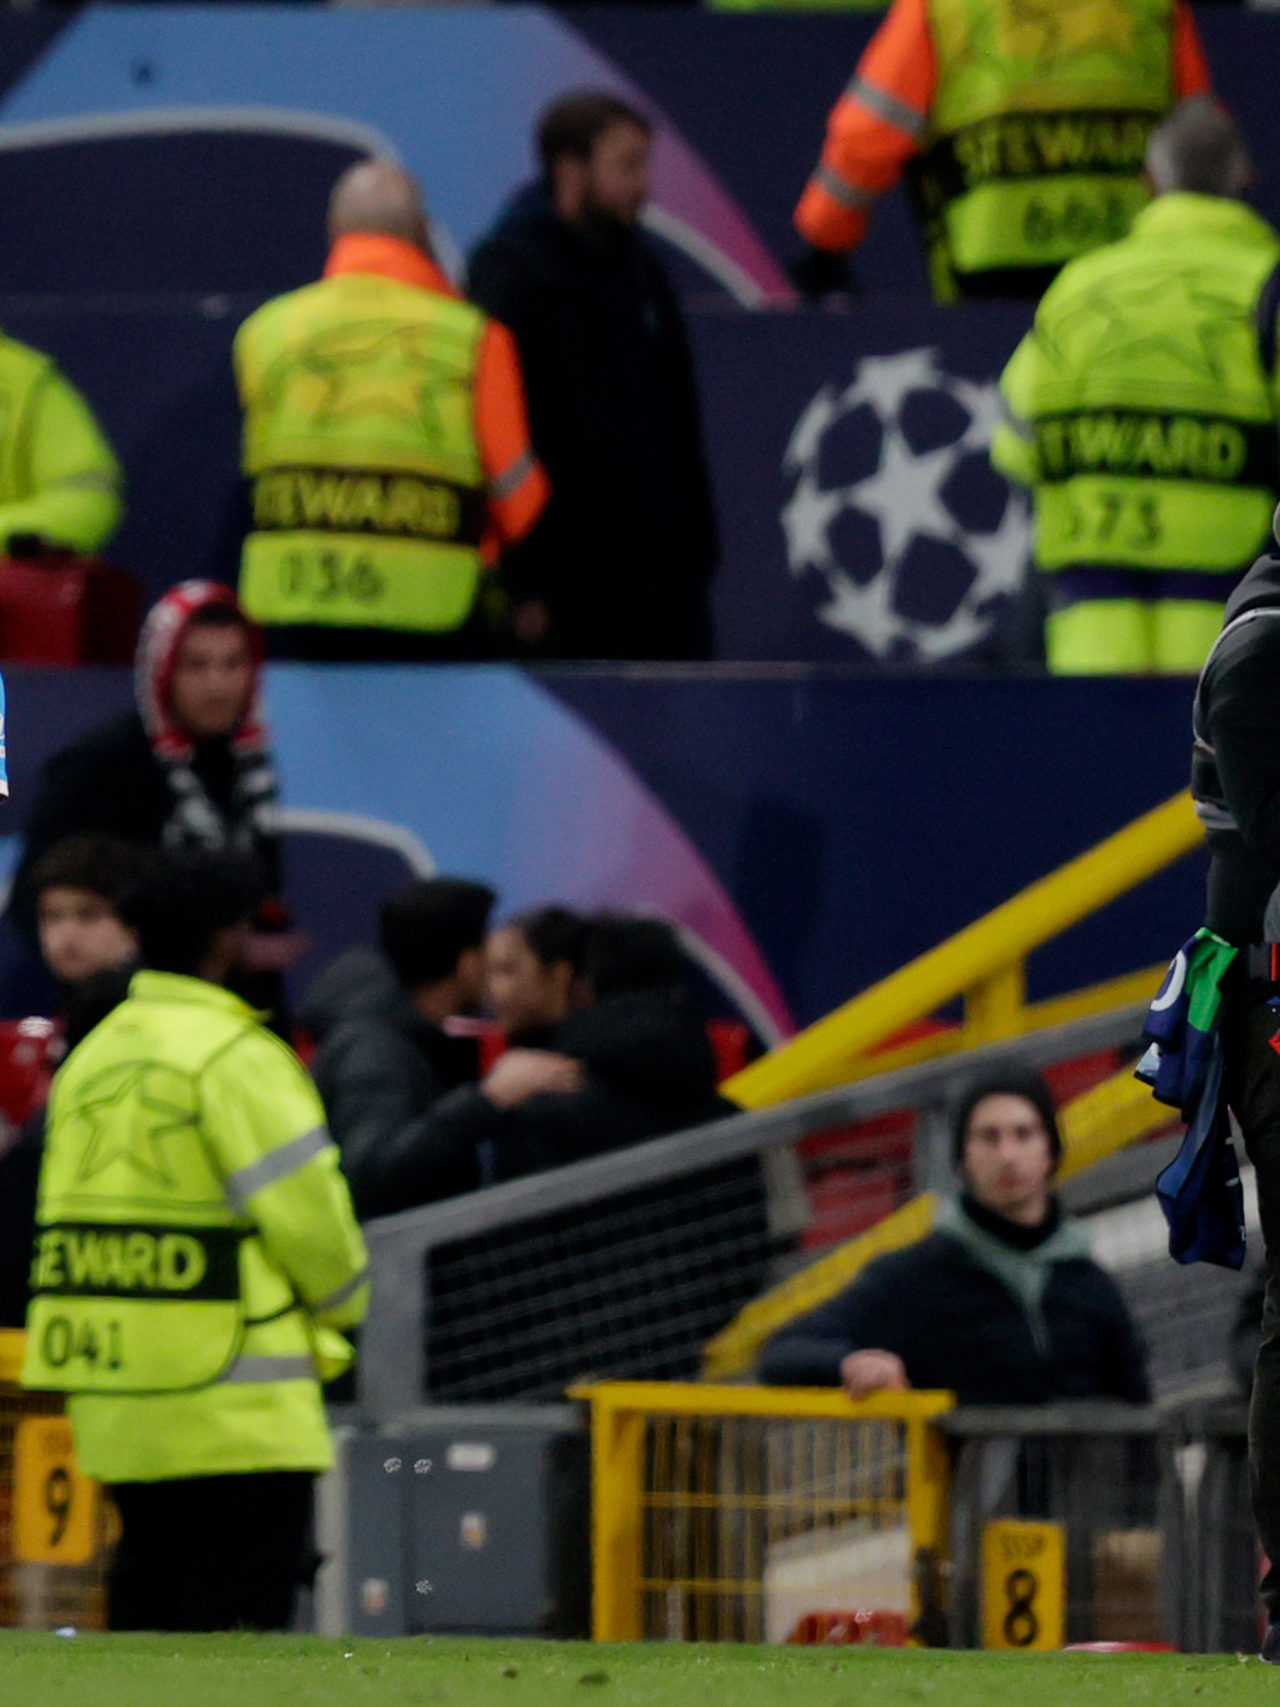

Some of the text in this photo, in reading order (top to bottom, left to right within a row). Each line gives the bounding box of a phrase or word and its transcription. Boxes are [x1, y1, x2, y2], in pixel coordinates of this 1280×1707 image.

[43, 1315, 123, 1371] 041
[45, 1466, 72, 1547] 9
[1004, 1568, 1040, 1648] 8
